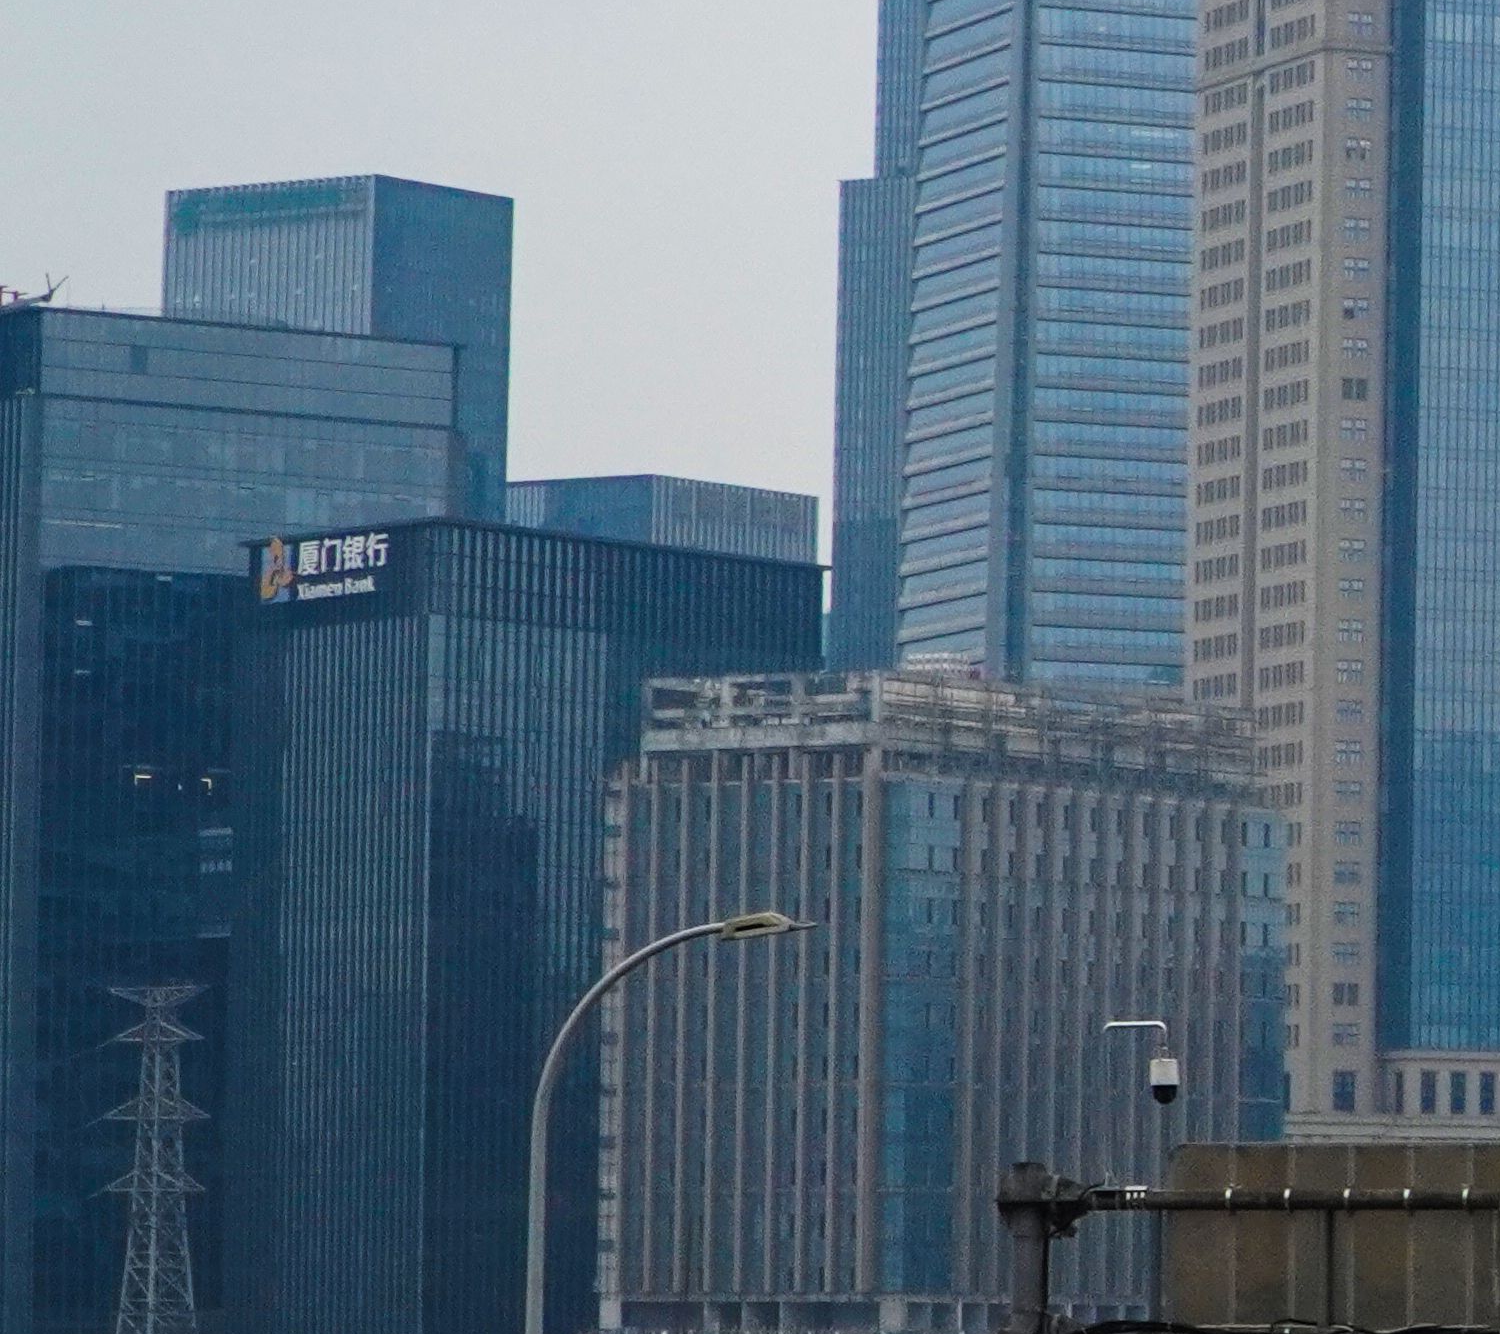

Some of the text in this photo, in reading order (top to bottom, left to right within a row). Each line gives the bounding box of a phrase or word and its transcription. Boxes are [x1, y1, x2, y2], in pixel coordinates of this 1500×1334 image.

[297, 532, 389, 576] 厦门银行
[297, 576, 376, 600] Xiamen Bank
